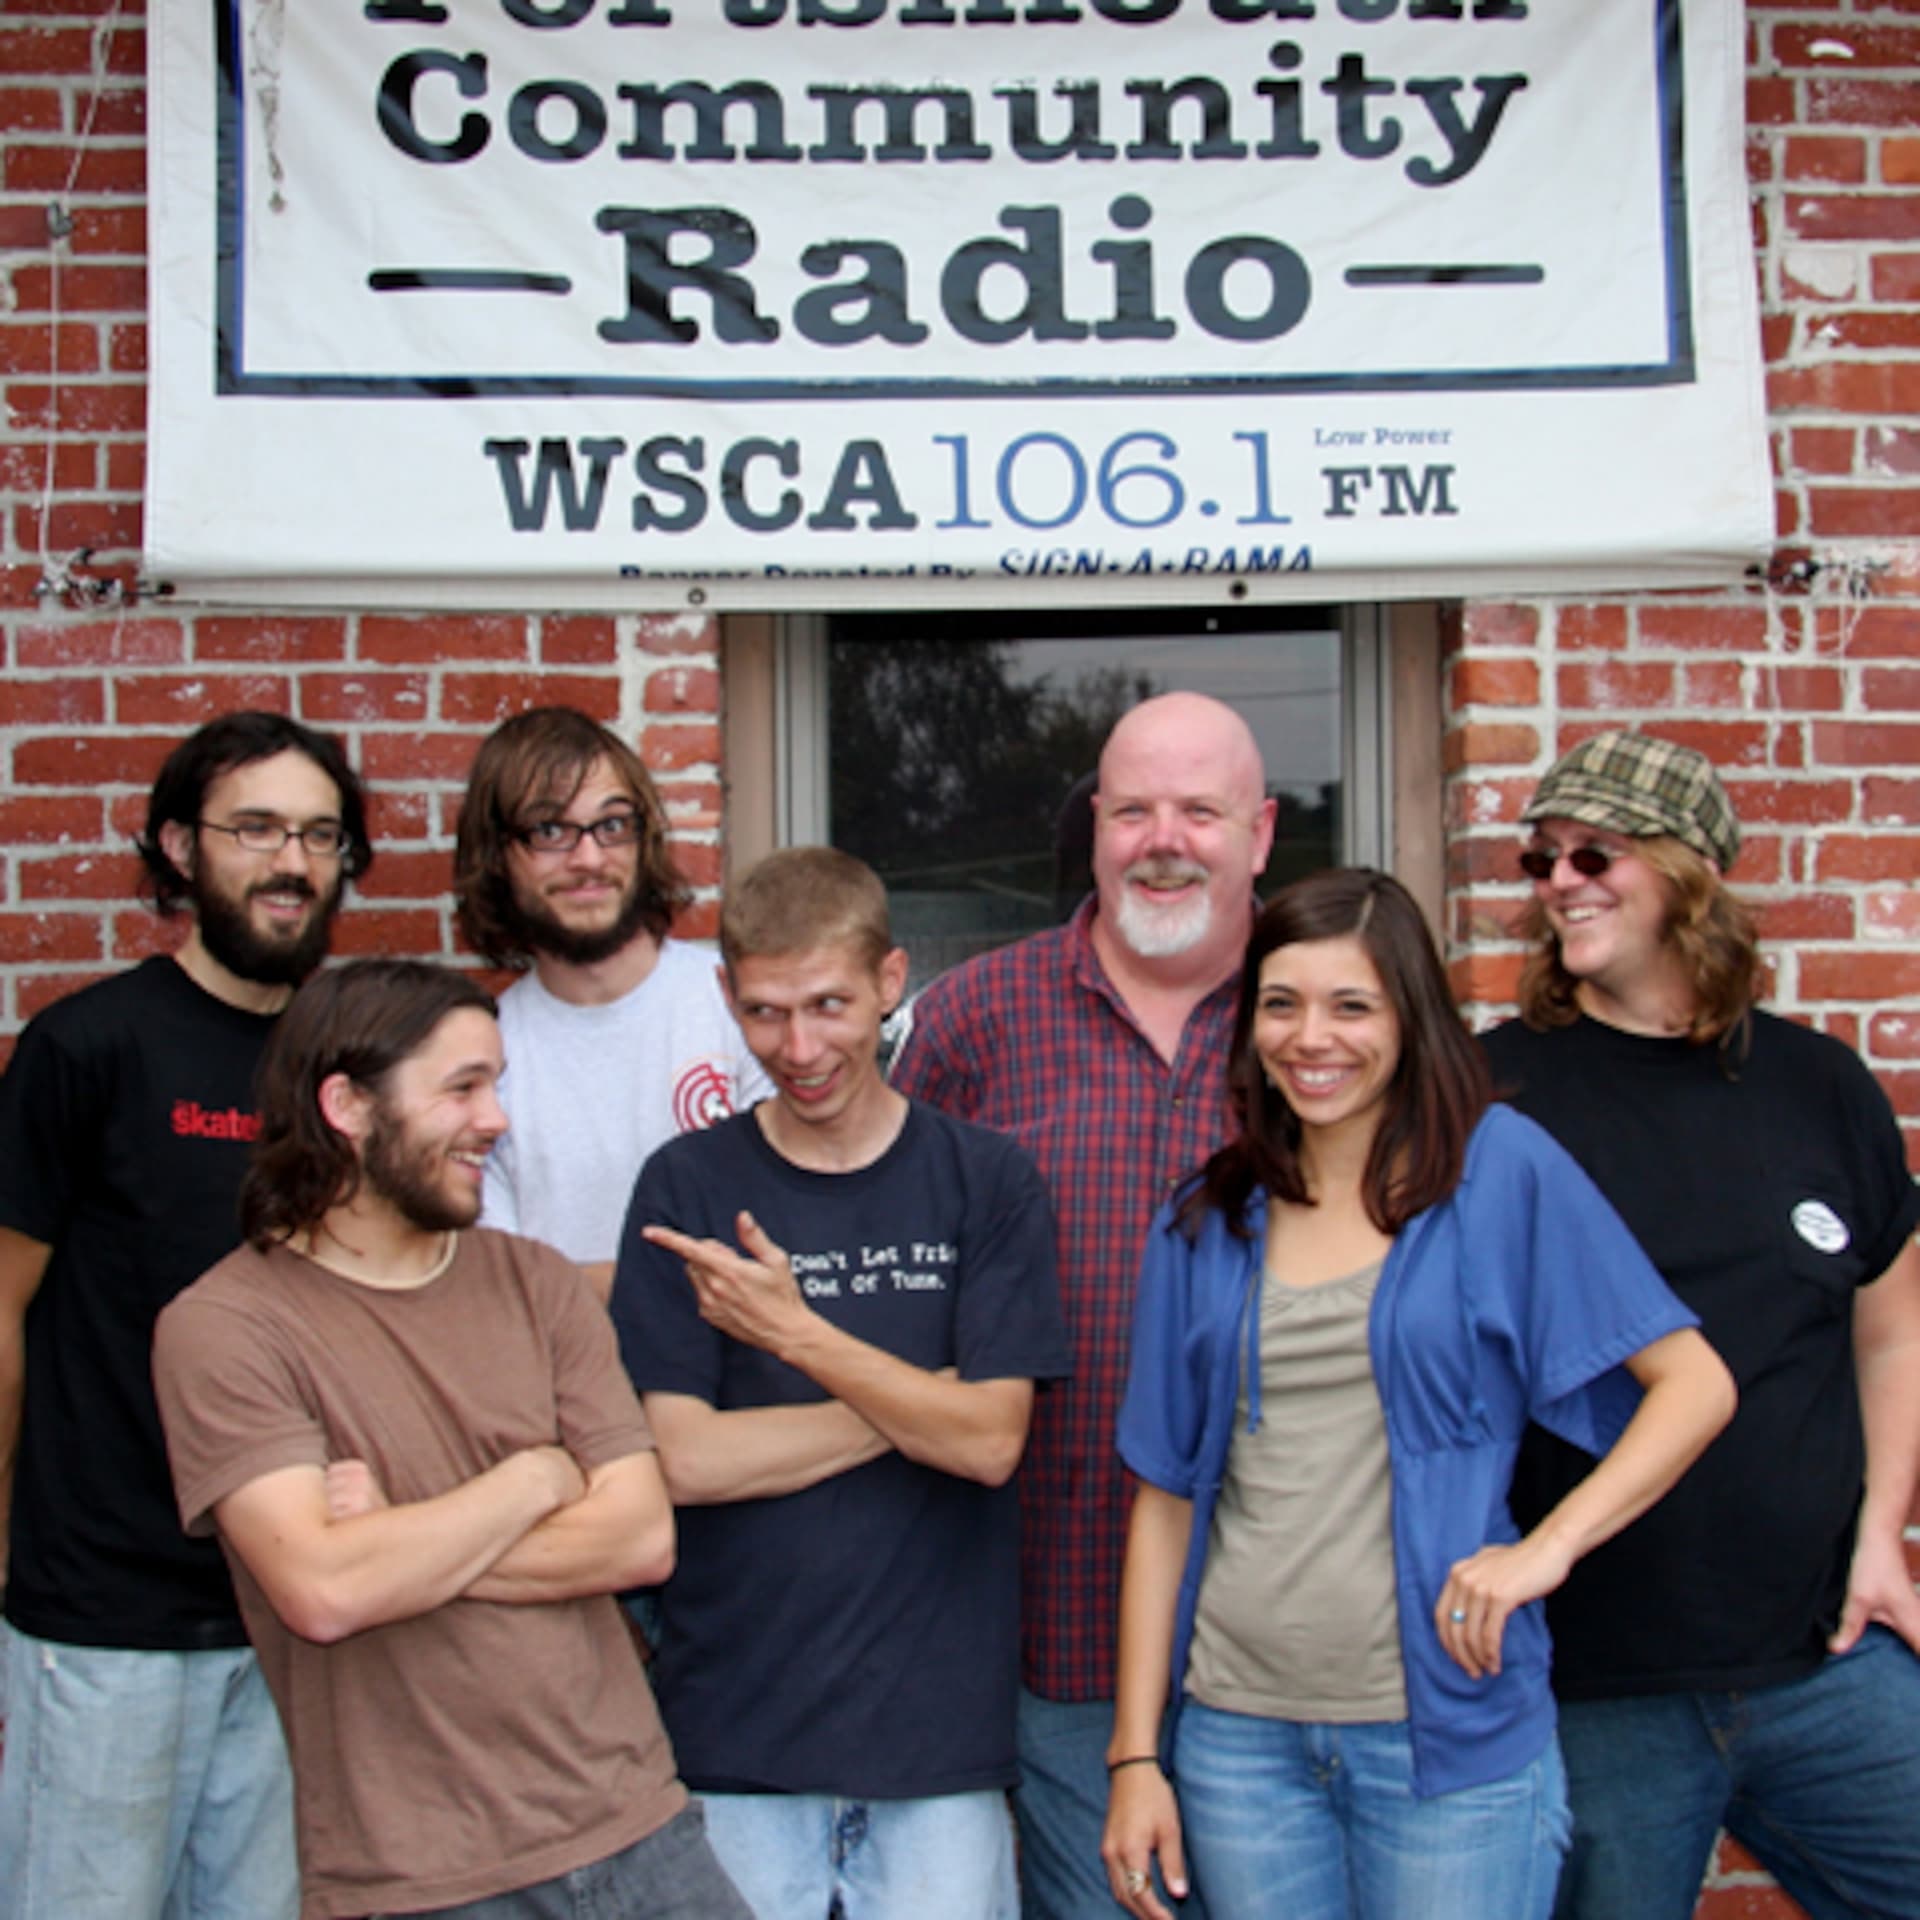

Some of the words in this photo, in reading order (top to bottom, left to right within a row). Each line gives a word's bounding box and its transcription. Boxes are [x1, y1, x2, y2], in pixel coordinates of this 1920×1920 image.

[376, 40, 1530, 187] Community
[595, 194, 1312, 346] Radio
[483, 433, 919, 532] WSCA
[932, 429, 1292, 529] 106.1
[1321, 464, 1459, 517] FM
[1314, 428, 1367, 446] Low
[1374, 427, 1453, 446] Power
[860, 1246, 899, 1267] Let
